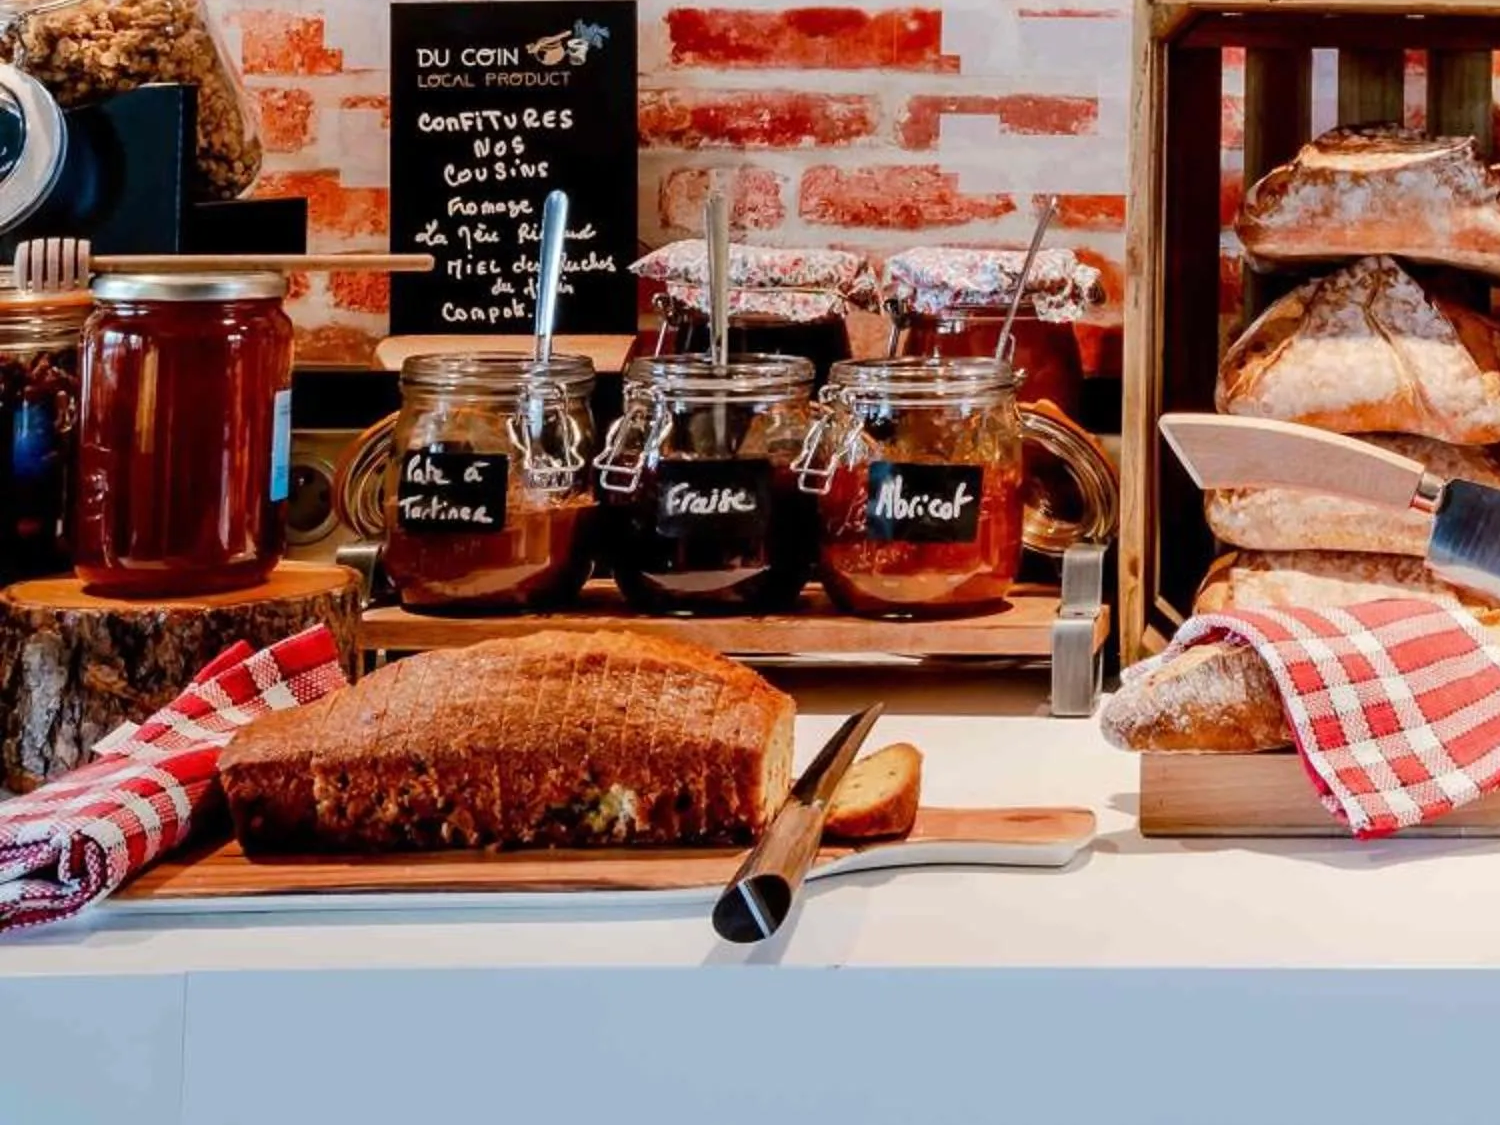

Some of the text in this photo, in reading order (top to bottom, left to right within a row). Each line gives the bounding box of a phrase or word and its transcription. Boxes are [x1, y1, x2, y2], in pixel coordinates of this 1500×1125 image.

[416, 48, 519, 67] DU COIN
[417, 72, 571, 88] LOCAL PRODUCT
[666, 482, 757, 515] Fraise
[875, 475, 974, 520] Abricot
